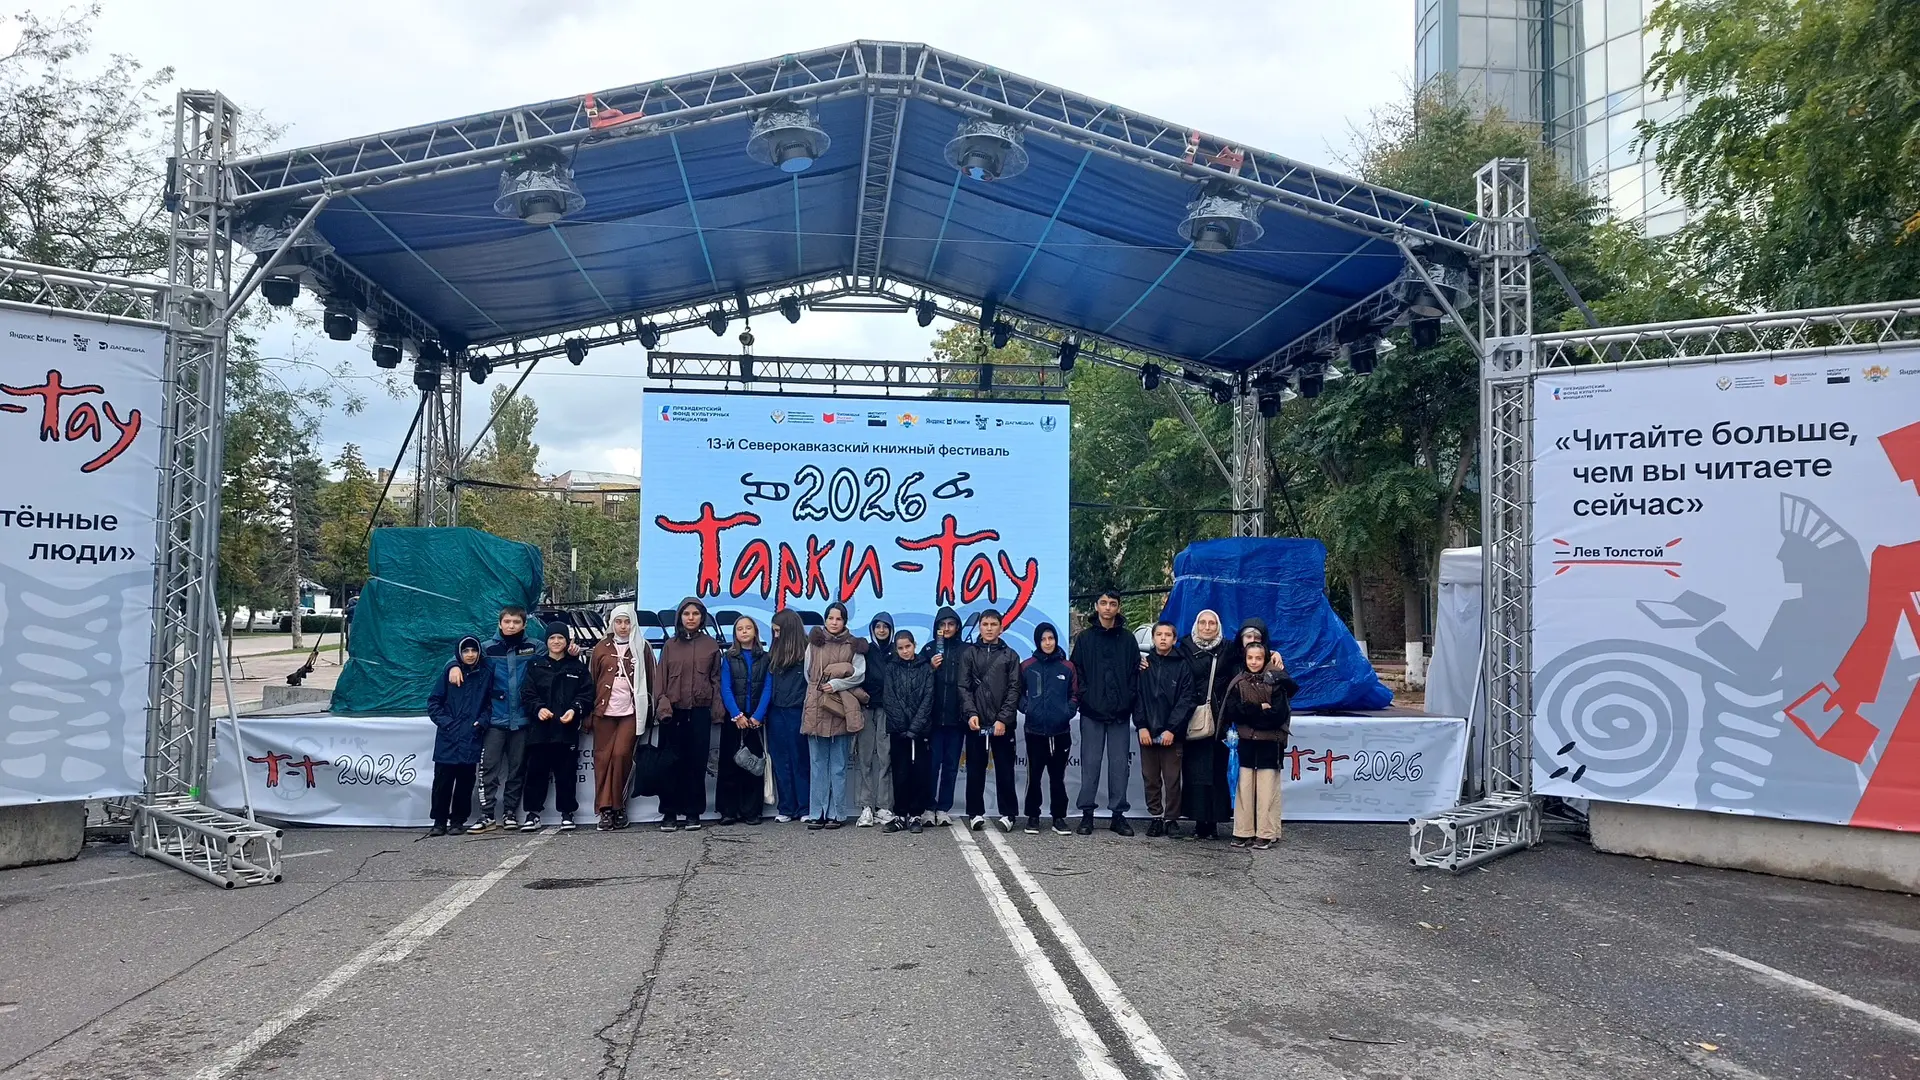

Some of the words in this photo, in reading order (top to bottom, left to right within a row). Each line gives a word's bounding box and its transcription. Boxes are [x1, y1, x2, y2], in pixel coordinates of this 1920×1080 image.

[9, 331, 35, 341] Яндекс
[45, 335, 67, 344] Книги
[706, 437, 735, 450] 13-й
[738, 438, 869, 454] Северокавказский
[872, 442, 935, 456] книжный
[938, 444, 1010, 458] фестиваль
[1555, 424, 1703, 452] «Читайте
[1711, 420, 1858, 447] больше,
[1573, 465, 1633, 484] чем
[1643, 461, 1685, 481] вы
[1695, 457, 1832, 480] читаете
[793, 464, 927, 523] 2026
[1573, 493, 1704, 516] сейчас»
[28, 543, 136, 565] люди»
[1573, 546, 1601, 558] Лев
[1604, 545, 1664, 558] Толстой
[334, 753, 417, 785] 2026
[1353, 750, 1424, 782] 2026
